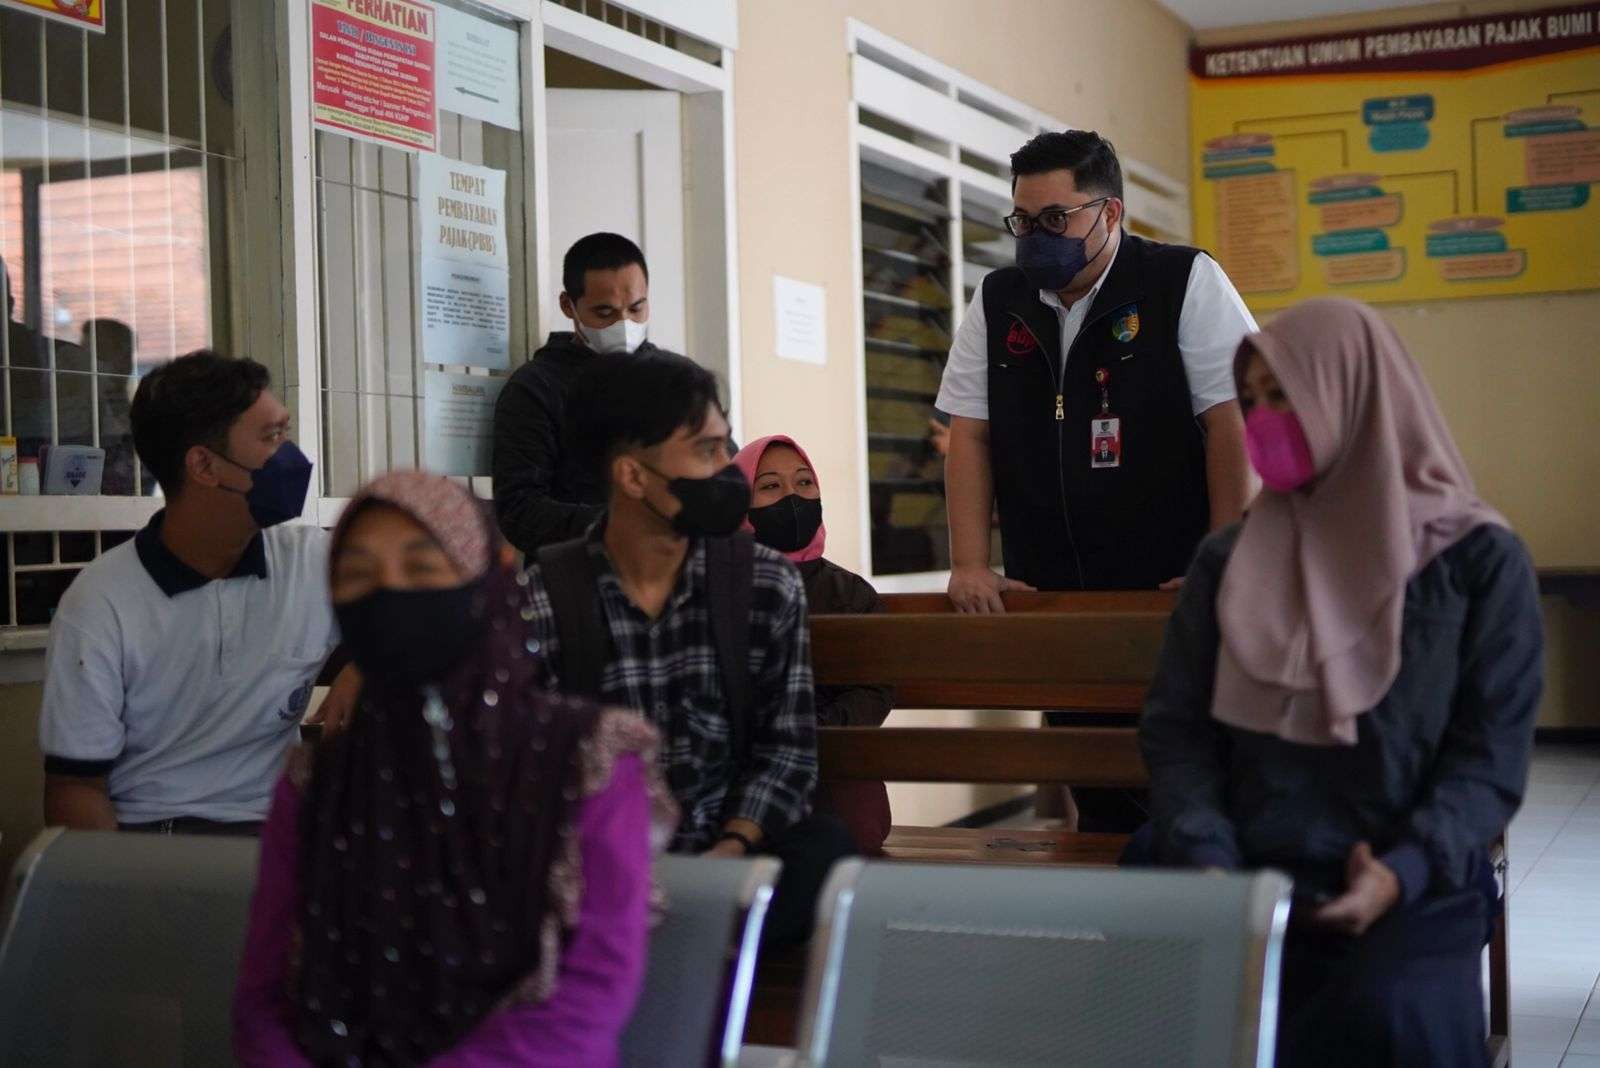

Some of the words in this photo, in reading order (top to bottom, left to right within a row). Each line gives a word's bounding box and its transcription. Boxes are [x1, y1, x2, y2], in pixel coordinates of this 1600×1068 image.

[1206, 44, 1306, 76] KETENTUAN
[1308, 38, 1358, 64] UMUM
[1364, 26, 1481, 58] PEMBAYARAN
[1484, 17, 1543, 46] PAJAK
[1547, 13, 1593, 37] BUMI
[449, 172, 485, 196] TEMPAT
[438, 196, 497, 225] PEMBAYARAN
[440, 225, 496, 255] PAJAK(PBB)
